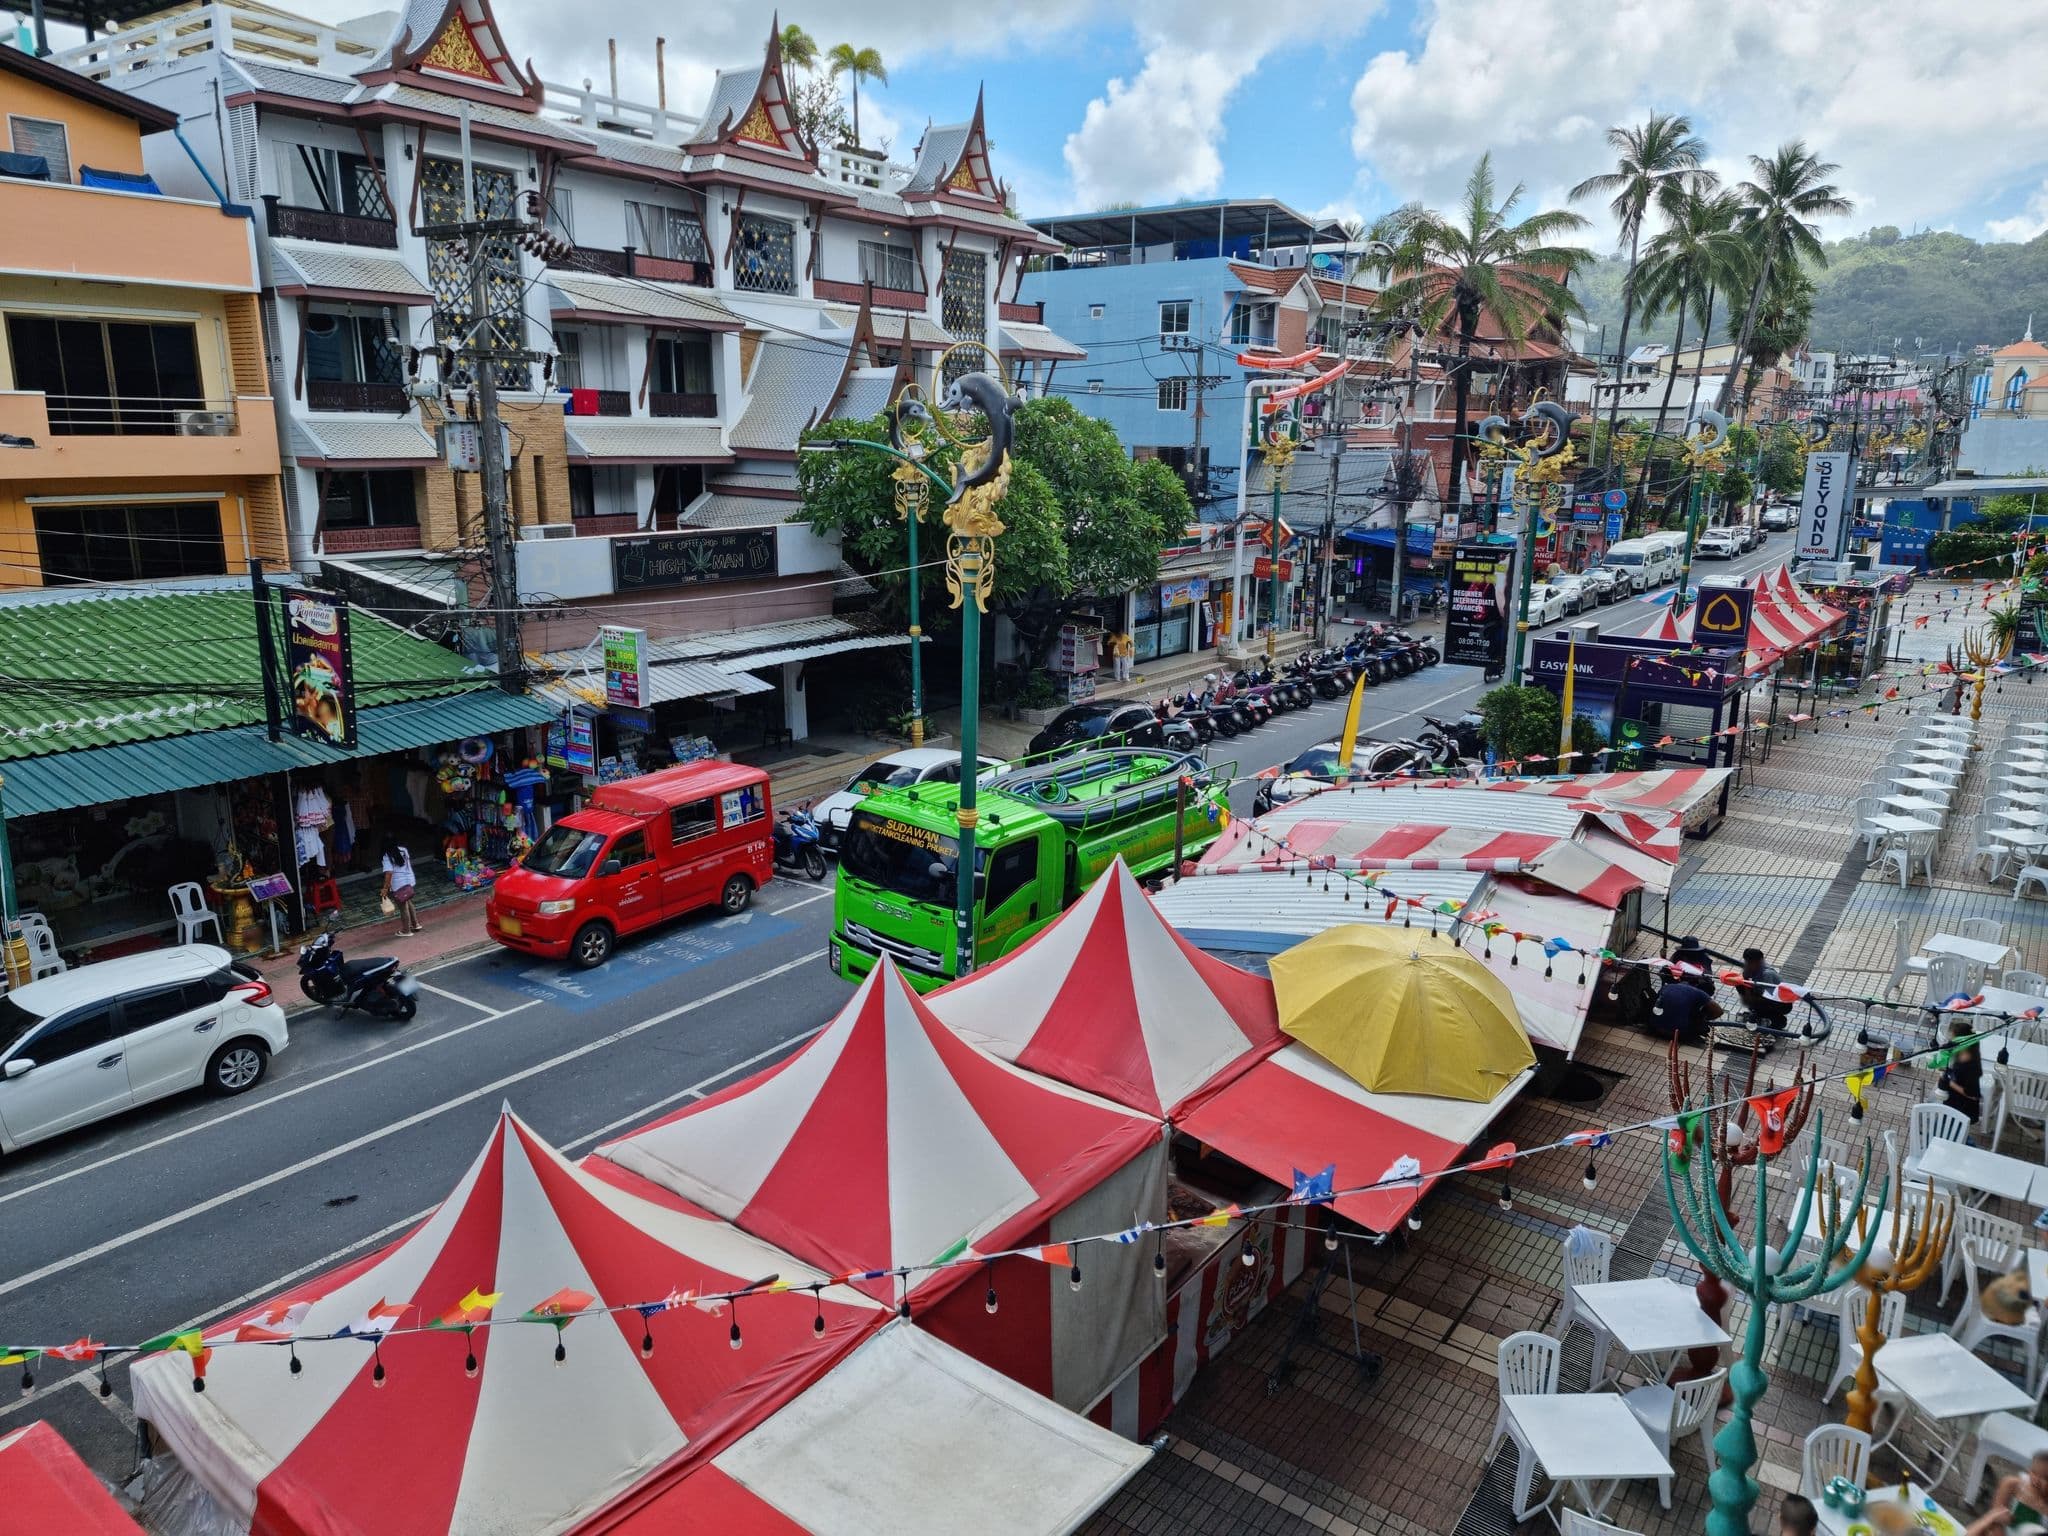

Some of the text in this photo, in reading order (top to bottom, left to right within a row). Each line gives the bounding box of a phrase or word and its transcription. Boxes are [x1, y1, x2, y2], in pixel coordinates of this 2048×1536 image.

[1810, 461, 1833, 546] BEYOND
[1802, 547, 1829, 555] PATONG
[649, 553, 744, 576] HIGH MAN
[1453, 590, 1482, 598] BEGINNER
[1452, 597, 1495, 606] INTERMEDIATE
[1452, 604, 1483, 612] ADVANCED
[886, 819, 940, 844] SUDAWAN
